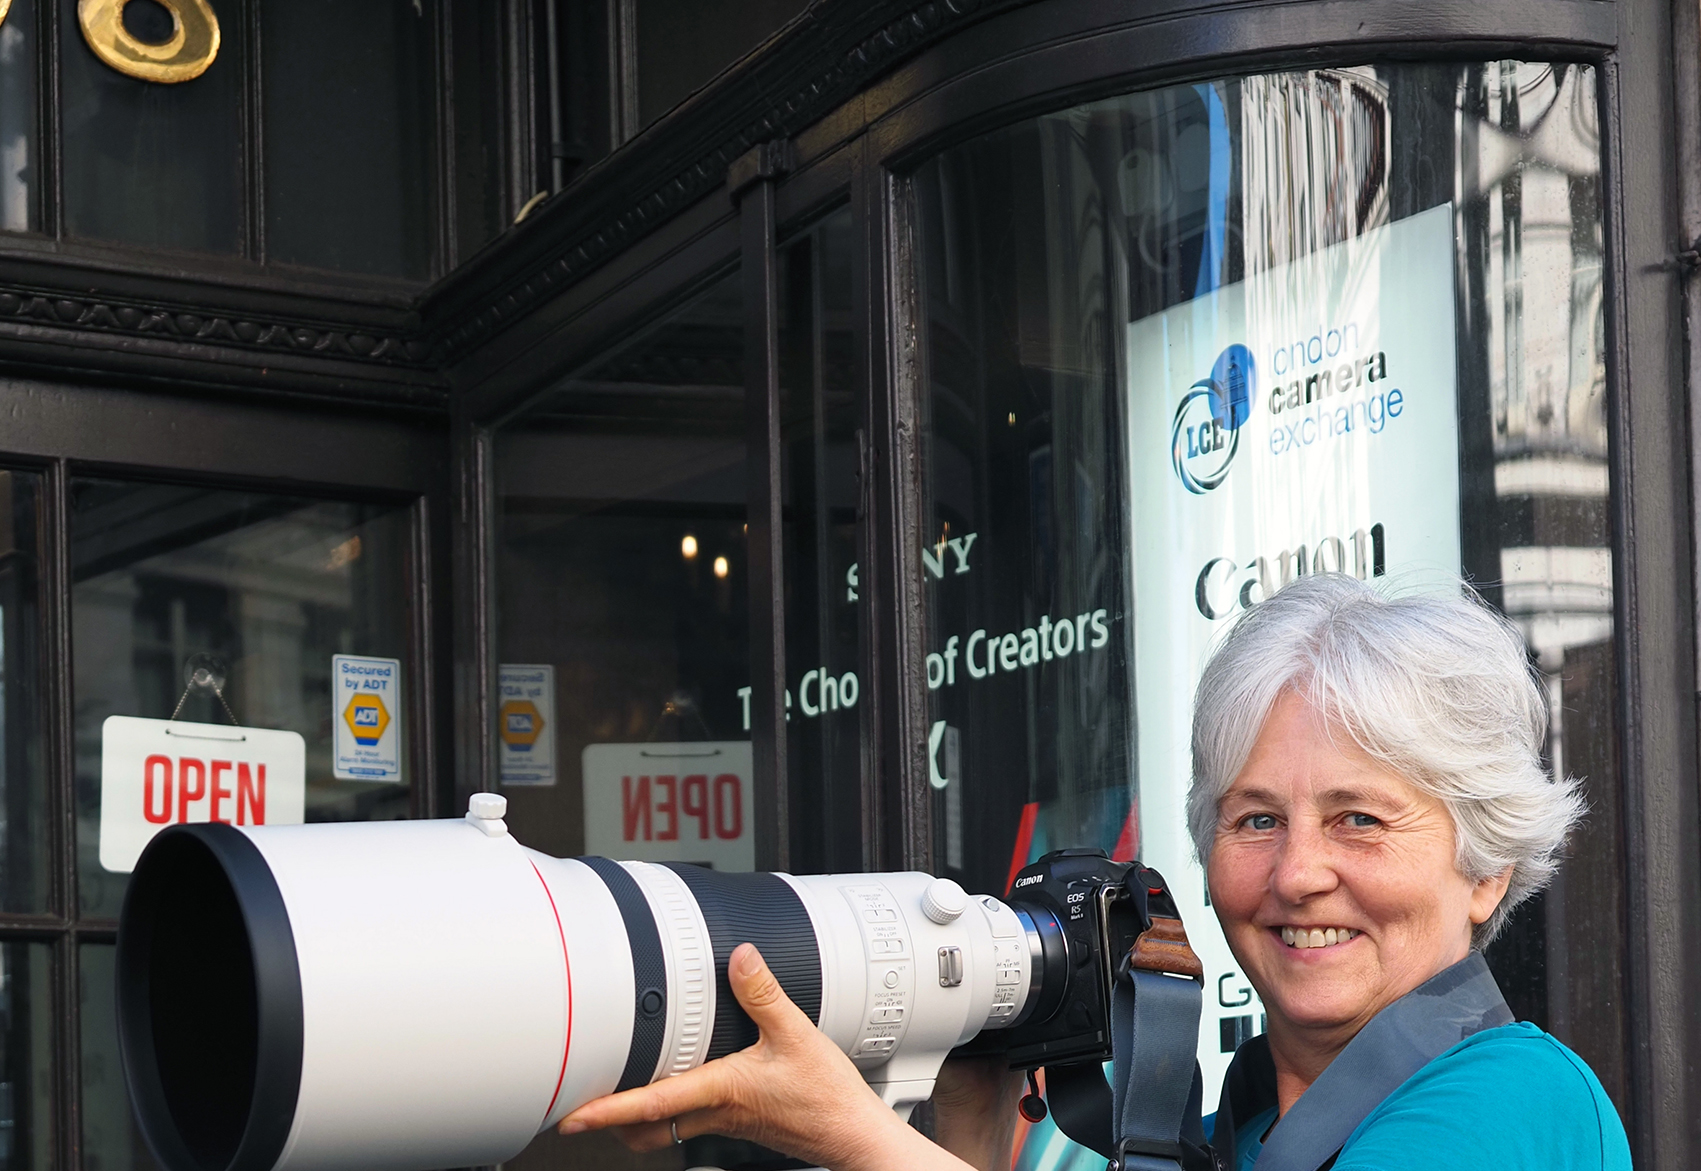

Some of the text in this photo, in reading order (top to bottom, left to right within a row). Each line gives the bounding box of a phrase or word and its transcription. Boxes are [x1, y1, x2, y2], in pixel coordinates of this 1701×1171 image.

[1268, 351, 1387, 415] camera
[1186, 417, 1225, 460] LCE
[1269, 388, 1404, 455] exchange
[847, 532, 977, 602] SNY
[342, 663, 391, 676] Secured
[345, 678, 388, 690] by ADT
[800, 667, 859, 717] Cho
[926, 635, 958, 690] of
[966, 608, 1109, 680] Creators
[355, 708, 378, 723] ADT
[143, 754, 266, 826] OPEN
[1015, 874, 1044, 888] Canon
[1067, 892, 1086, 903] EOS
